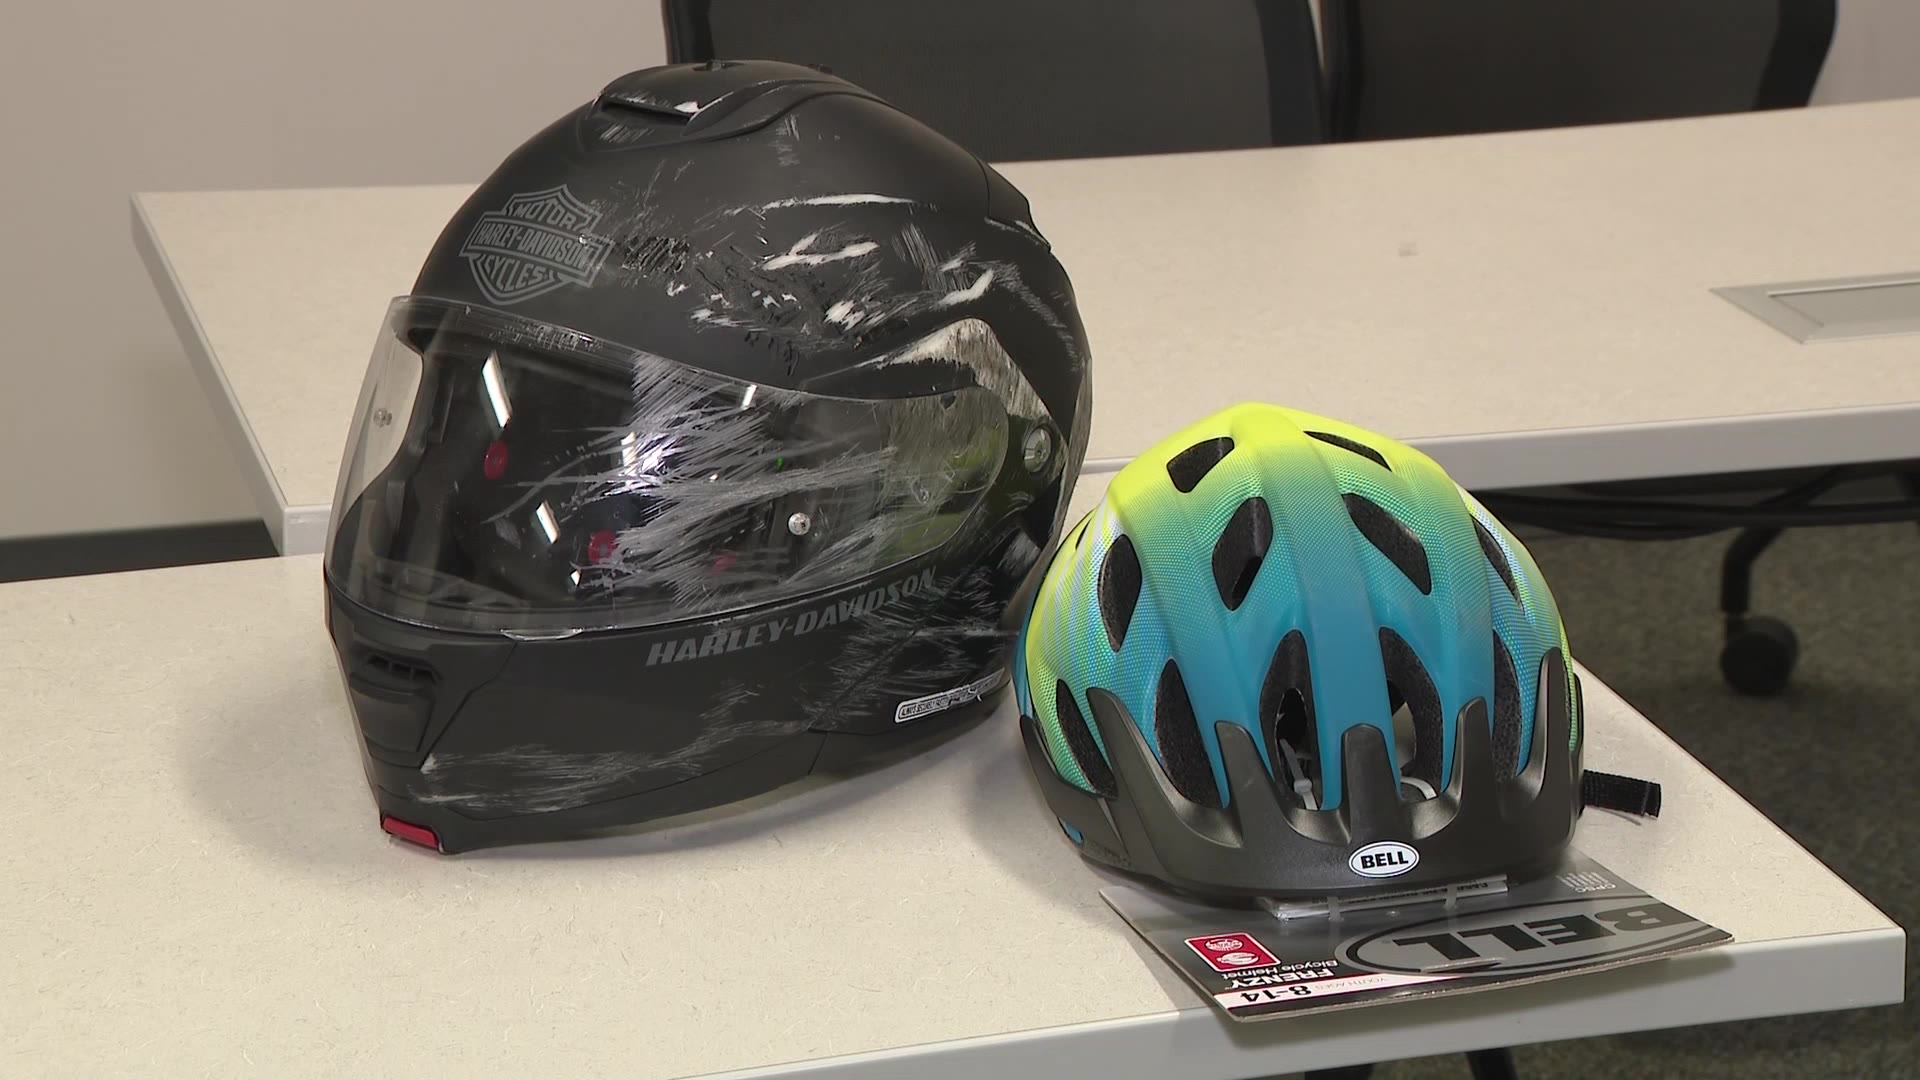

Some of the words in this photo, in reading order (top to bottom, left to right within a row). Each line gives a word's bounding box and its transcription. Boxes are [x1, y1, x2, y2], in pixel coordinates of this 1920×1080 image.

[512, 198, 577, 231] MOTOR
[474, 223, 597, 270] HARLEY-DAVIDSON
[484, 254, 546, 292] CYCLES
[645, 565, 936, 667] HARLEY-DAVIDSON
[1360, 851, 1409, 869] BELL
[1392, 902, 1698, 960] BELL
[1221, 967, 1278, 980] Helmet
[1231, 968, 1334, 989] FRENZY
[1281, 960, 1338, 971] Bicycle
[1240, 985, 1312, 1002] 8-14
